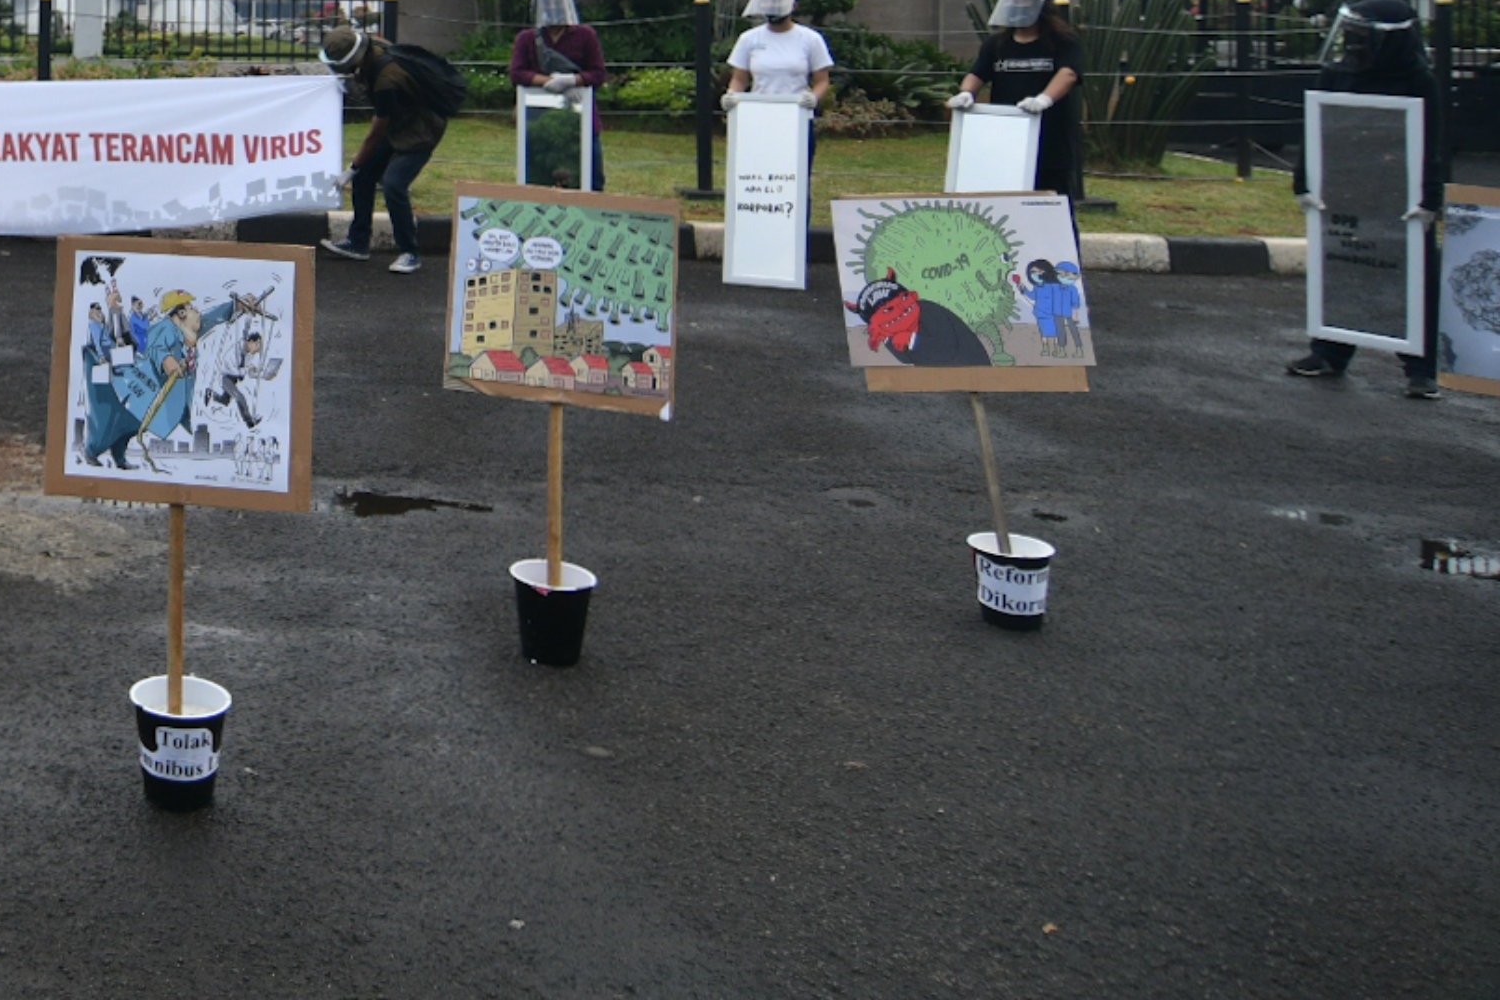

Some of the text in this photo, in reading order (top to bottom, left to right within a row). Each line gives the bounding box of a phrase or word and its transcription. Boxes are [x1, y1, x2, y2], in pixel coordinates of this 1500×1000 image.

[88, 132, 234, 165] TERANCAM
[242, 128, 323, 164] VIRUS
[921, 252, 971, 280] COVID-19
[158, 729, 211, 750] Tolak
